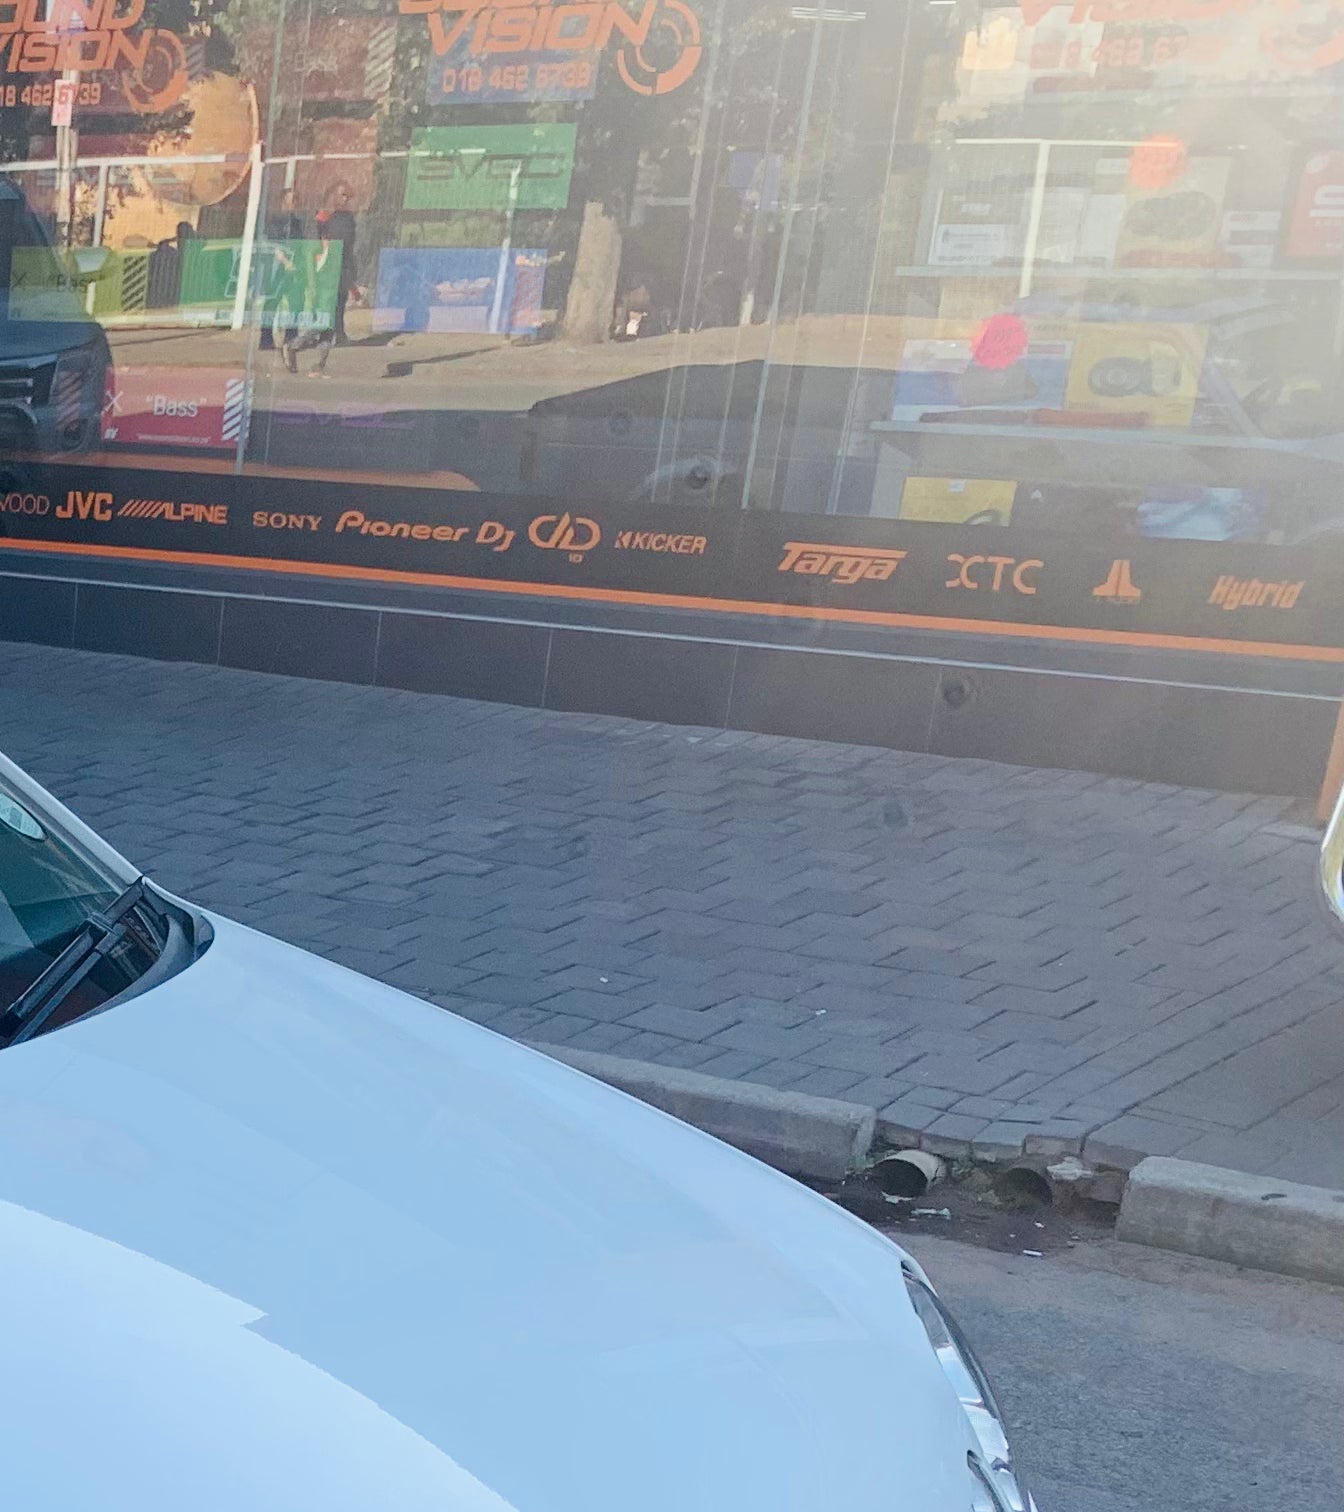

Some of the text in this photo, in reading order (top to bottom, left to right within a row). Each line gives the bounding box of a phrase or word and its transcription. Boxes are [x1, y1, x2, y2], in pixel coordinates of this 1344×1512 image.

[427, 0, 656, 56] VISION
[55, 491, 113, 521] JVC
[140, 500, 228, 525] ALPINE
[252, 511, 322, 531] SONY
[335, 510, 470, 543] Pioneer
[630, 531, 708, 555] KICKER
[776, 541, 908, 584] Targa
[1208, 575, 1306, 610] Hybrid
